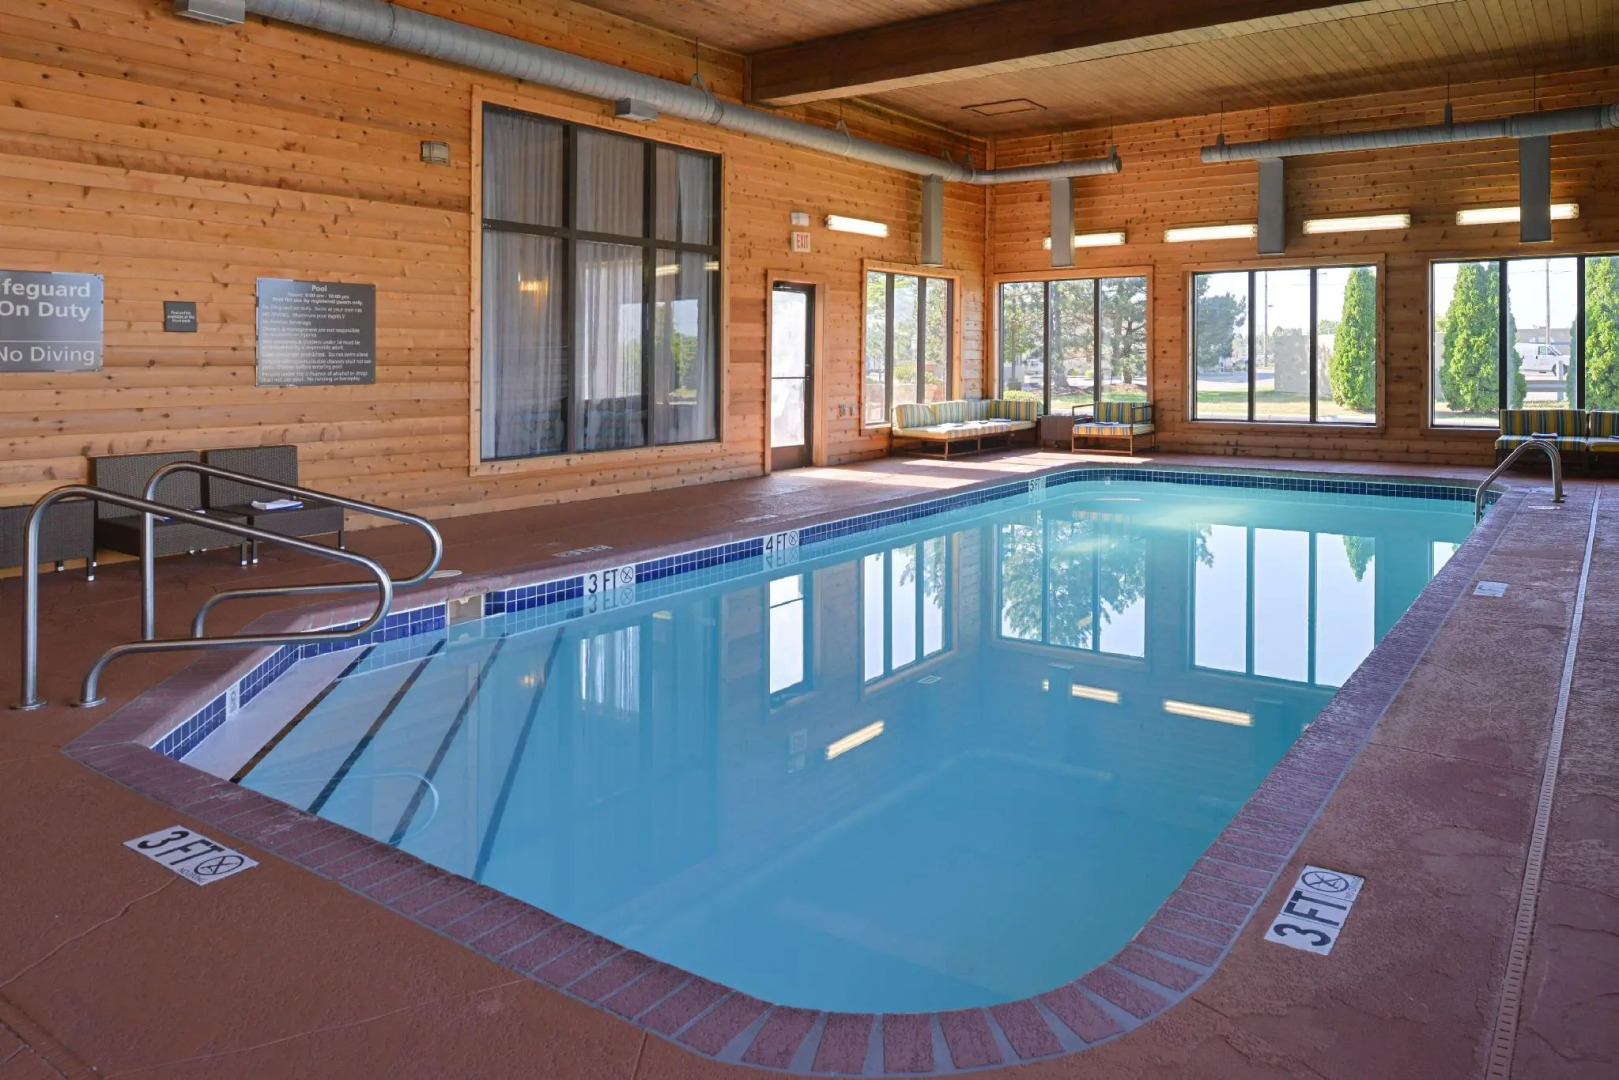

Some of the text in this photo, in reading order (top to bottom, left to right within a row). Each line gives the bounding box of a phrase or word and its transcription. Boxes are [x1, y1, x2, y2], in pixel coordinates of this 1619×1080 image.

[0, 301, 91, 322] On Duty
[0, 346, 95, 366] No Diving
[765, 532, 787, 553] 4 FT
[588, 568, 619, 594] 3 FT
[137, 830, 226, 866] 3 FT
[1273, 890, 1347, 947] 3 FT
